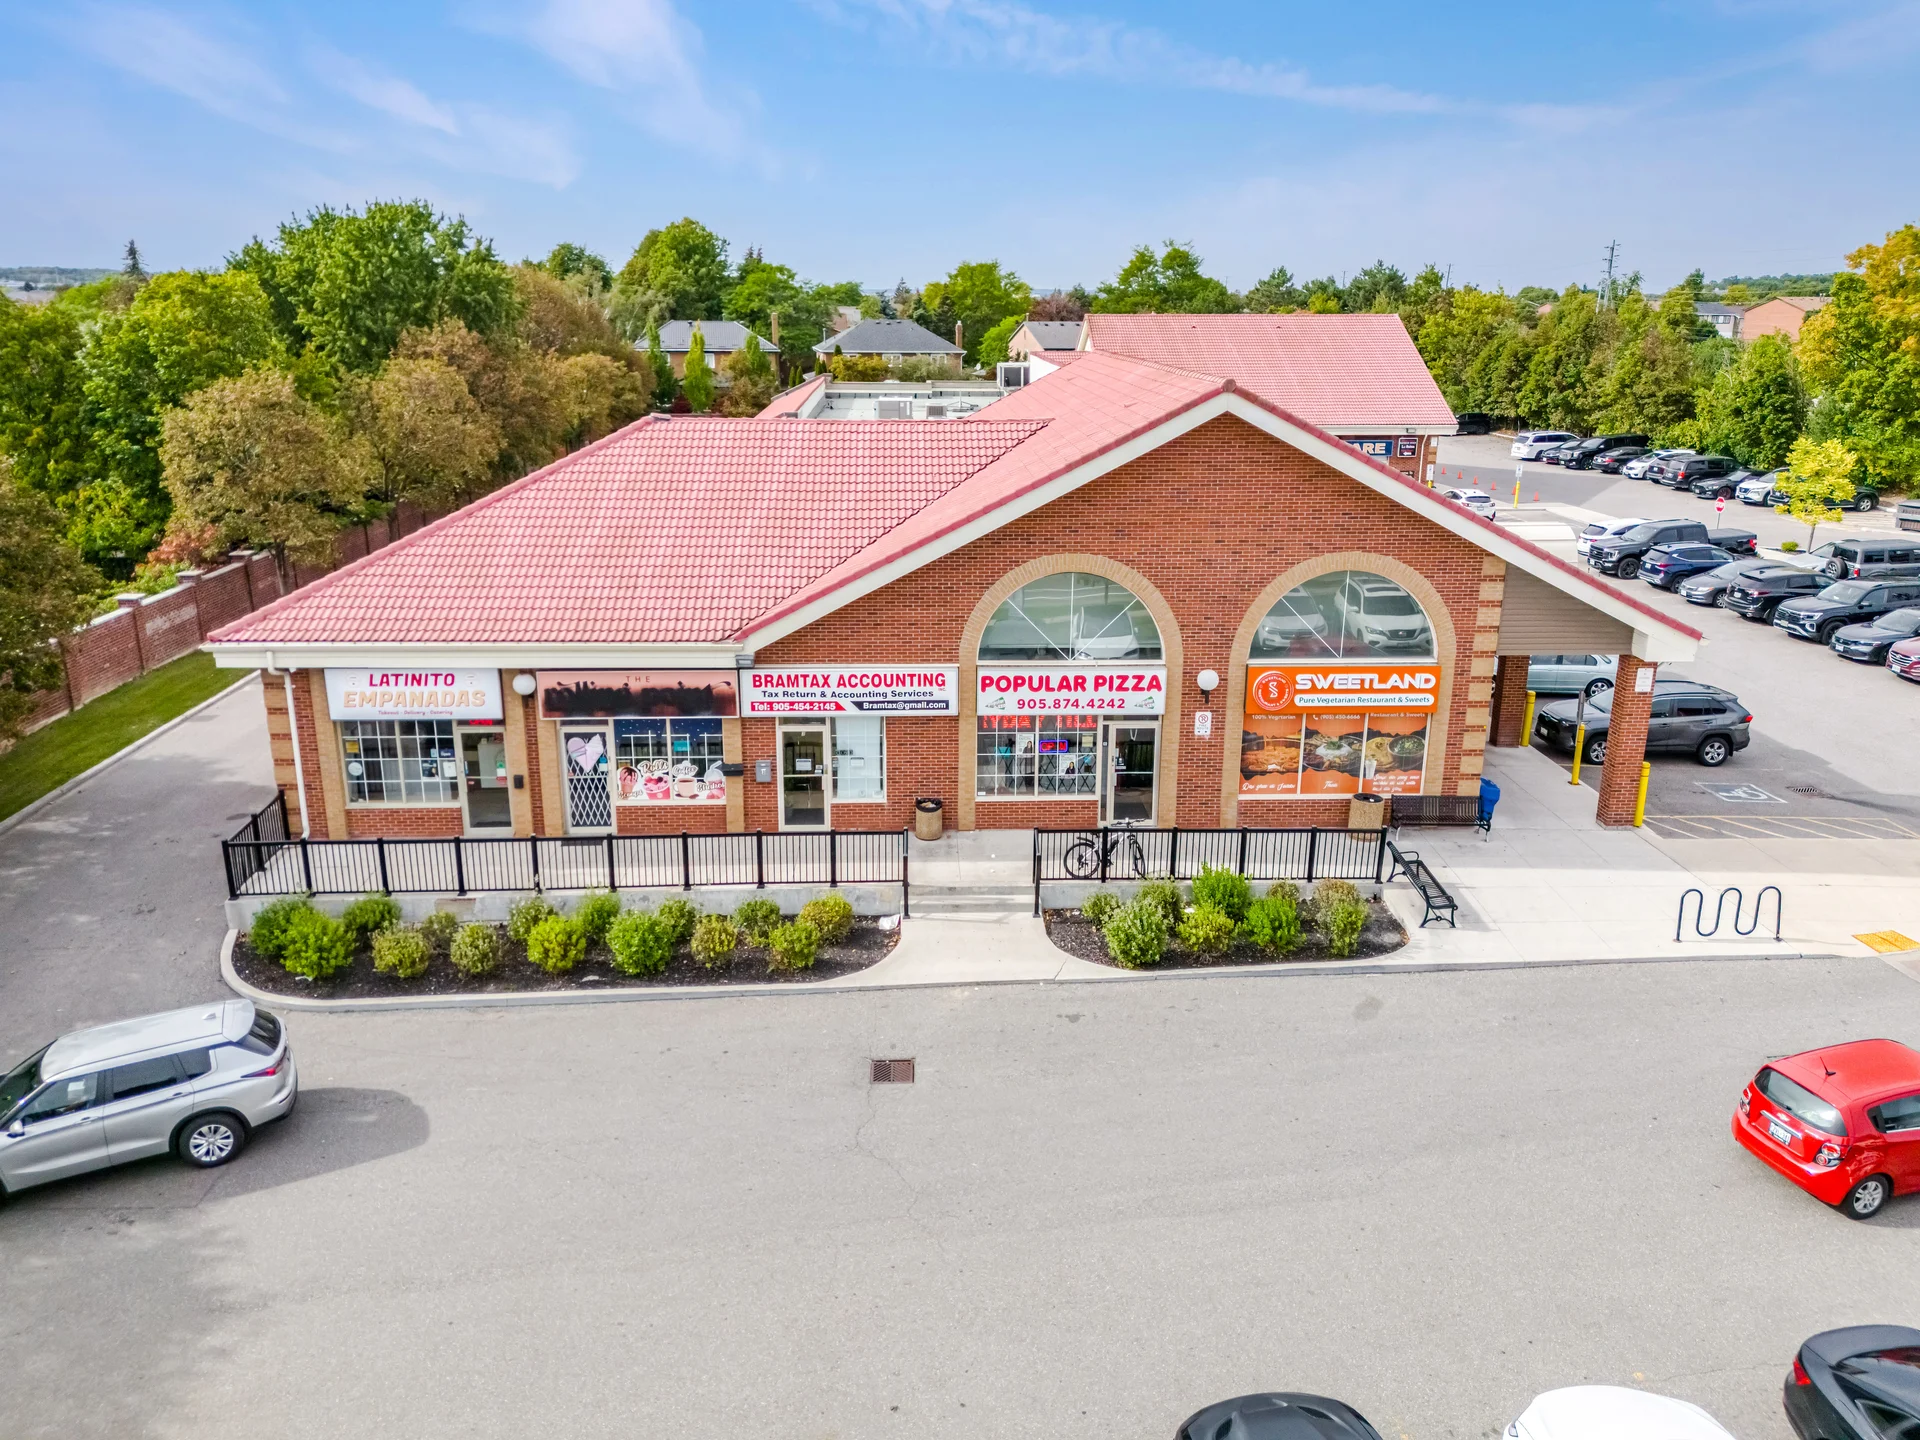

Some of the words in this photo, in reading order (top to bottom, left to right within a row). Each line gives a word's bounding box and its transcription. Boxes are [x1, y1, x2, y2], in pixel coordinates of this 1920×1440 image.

[369, 673, 455, 687] LATINITO
[752, 673, 831, 688] BRAMTAX
[837, 672, 946, 688] ACCOUNTING
[980, 675, 1087, 692] POPULAR
[1094, 674, 1163, 692] PIZZA
[1295, 673, 1436, 690] SWEETLAND
[343, 690, 486, 708] EMPANADAS
[762, 690, 779, 698] Tax
[782, 690, 817, 698] Return
[831, 690, 888, 699] Accounting
[891, 690, 934, 698] Services
[1317, 696, 1356, 704] Vegetarian
[753, 702, 770, 711] Tel:
[772, 702, 836, 711] 905-454-2145
[863, 701, 946, 710] Bramtax@gmail.com
[1017, 698, 1126, 710] 905.874.4242
[1041, 742, 1067, 751] OPN
[642, 760, 669, 773] Rolls
